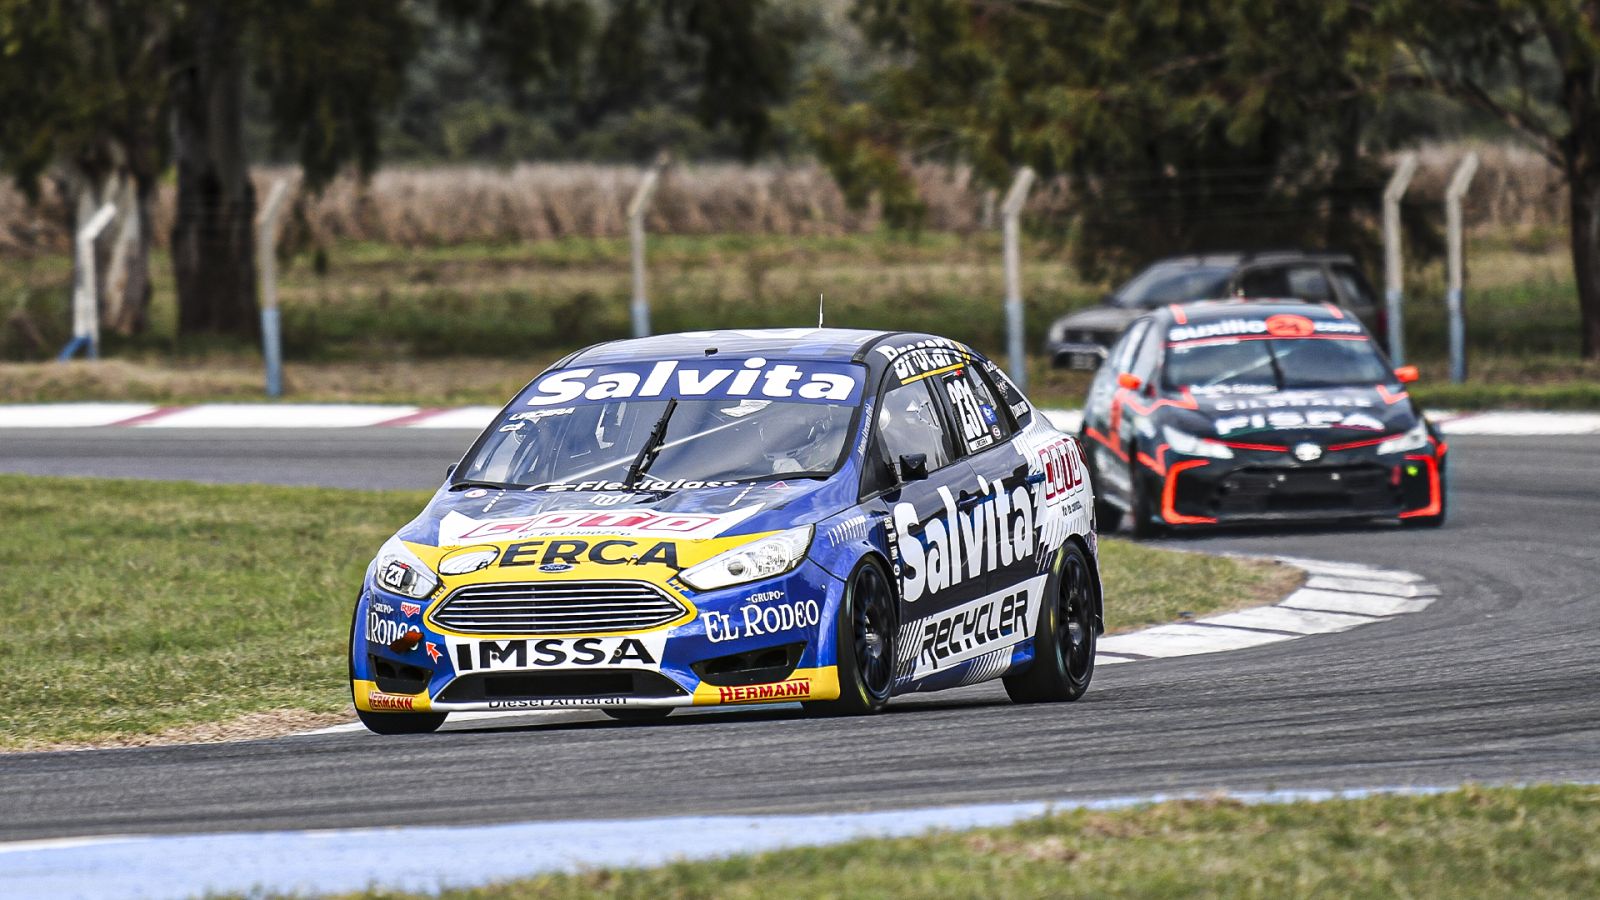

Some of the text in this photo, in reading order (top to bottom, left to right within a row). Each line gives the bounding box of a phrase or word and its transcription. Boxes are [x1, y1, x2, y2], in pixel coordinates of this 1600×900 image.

[526, 357, 856, 406] Salvita
[946, 377, 989, 440] 231
[499, 540, 679, 569] ERCA
[893, 474, 1034, 602] Salvita
[456, 637, 656, 671] IMSSA
[921, 590, 1029, 669] RECYCLER
[719, 682, 810, 703] HERMANN
